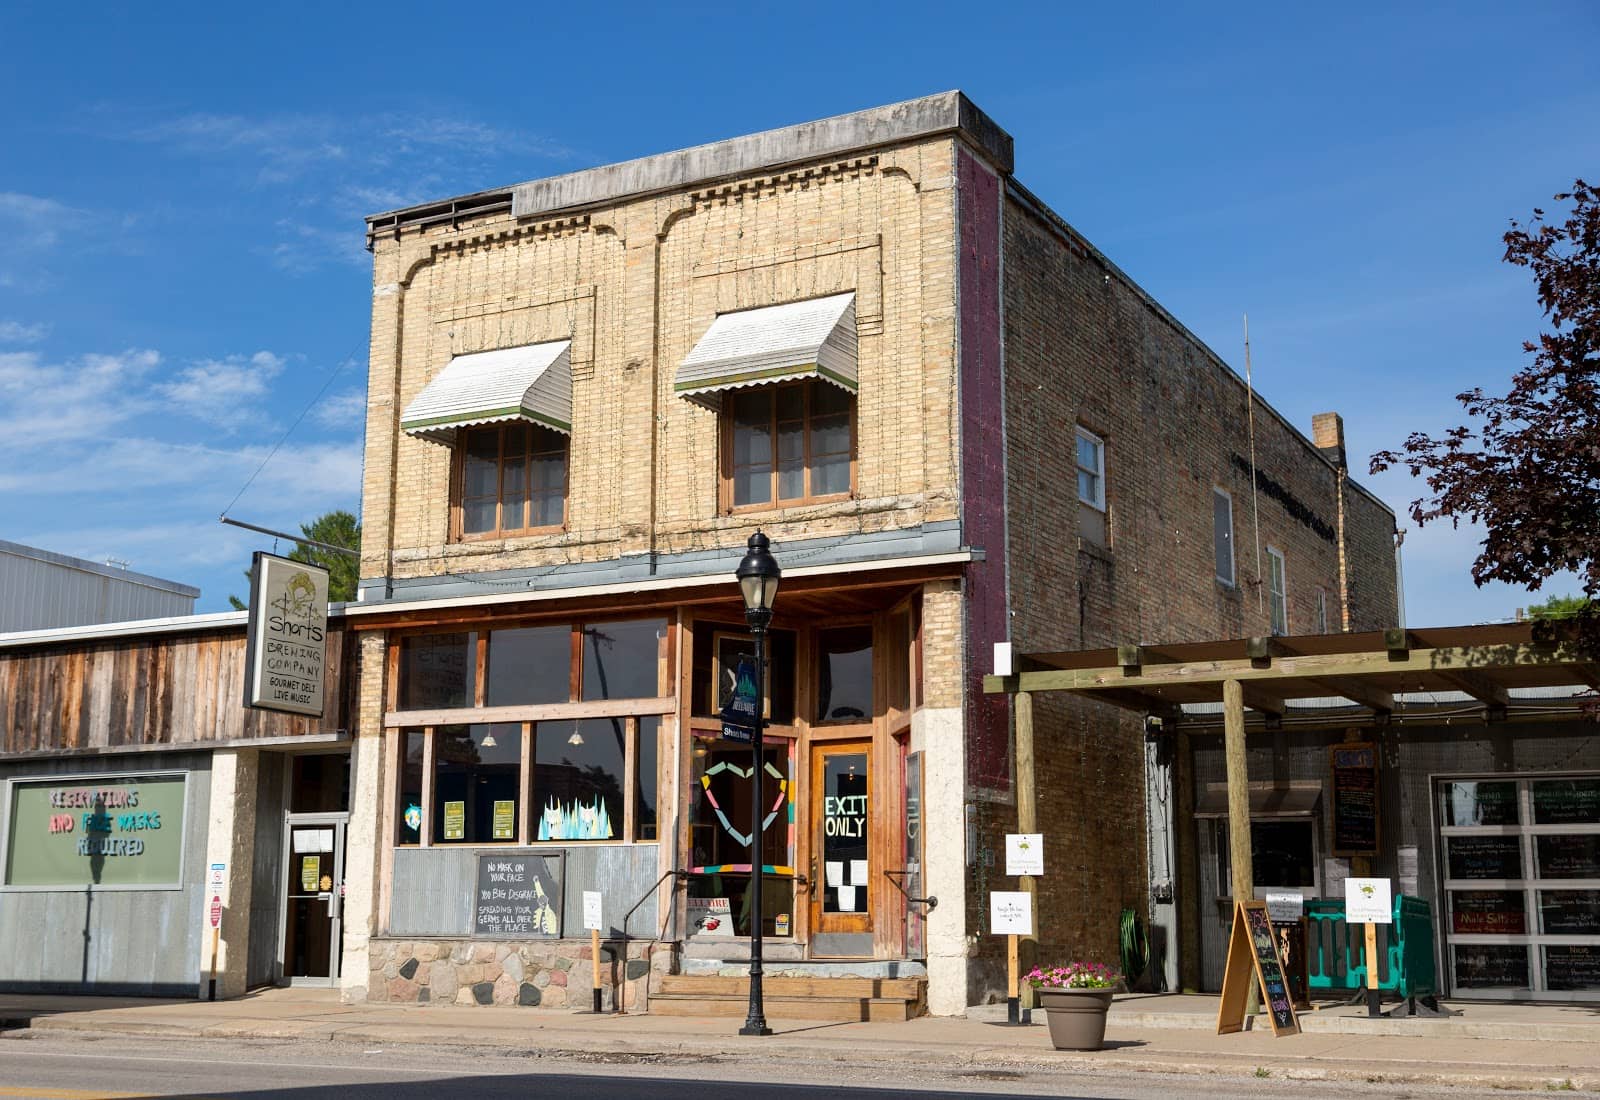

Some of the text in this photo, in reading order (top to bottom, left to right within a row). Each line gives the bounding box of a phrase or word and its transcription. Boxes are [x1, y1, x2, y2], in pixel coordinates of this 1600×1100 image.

[267, 642, 321, 663] BREWING
[267, 657, 320, 681] COMPANY
[269, 676, 316, 693] GOURMET DELI
[274, 689, 311, 704] LIVE MUSIC
[825, 795, 868, 815] EXIT
[48, 813, 74, 833] AND
[117, 810, 161, 832] MASKS
[825, 816, 866, 837] ONLY
[77, 838, 144, 856] REQUIRED
[487, 862, 525, 873] NO MASK ON
[490, 873, 525, 882] YOUR FACE
[481, 889, 491, 900] YOU
[492, 888, 506, 899] BIG
[515, 905, 531, 915] YOUR
[478, 915, 532, 924] GERMS ALL OVER
[487, 923, 527, 933] THE PLACE
